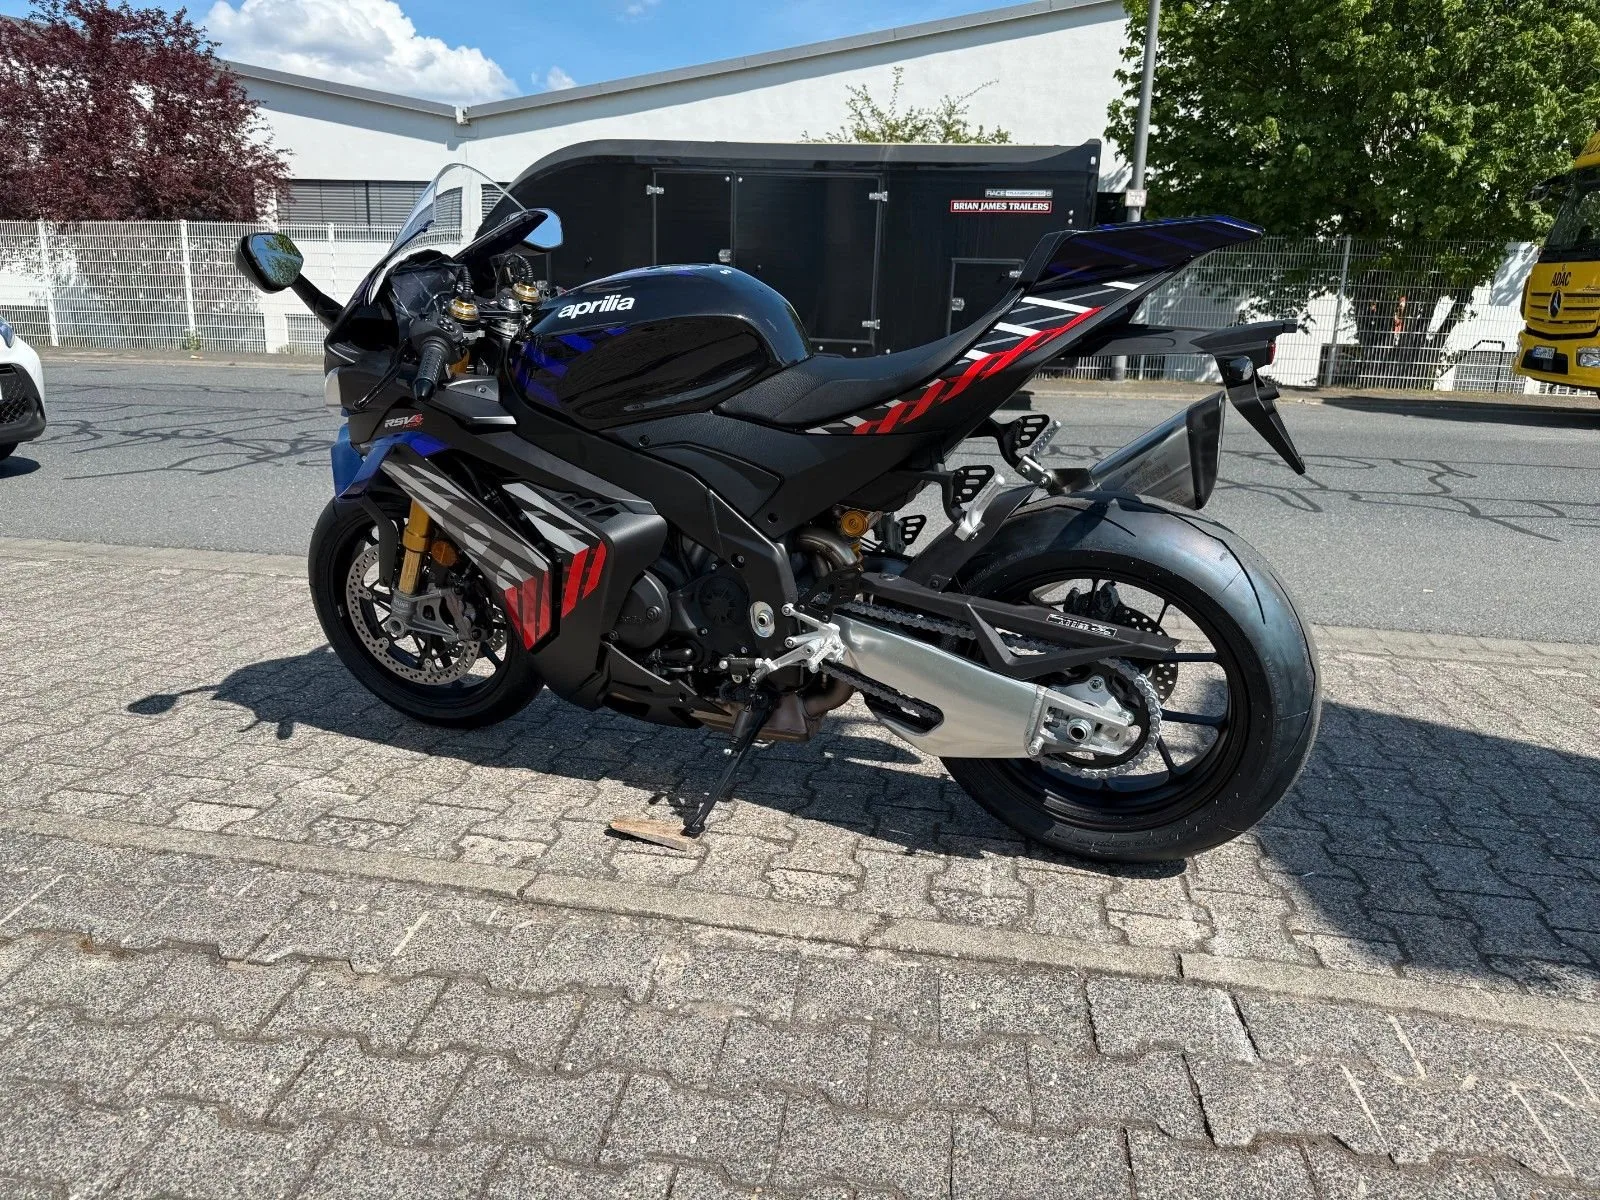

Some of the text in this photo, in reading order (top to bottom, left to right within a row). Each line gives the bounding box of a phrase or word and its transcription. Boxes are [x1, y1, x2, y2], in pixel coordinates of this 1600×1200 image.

[953, 202, 1049, 211] BRIAN JAMES TRAILERS
[1551, 271, 1572, 287] ADAC
[558, 294, 635, 319] aprilia
